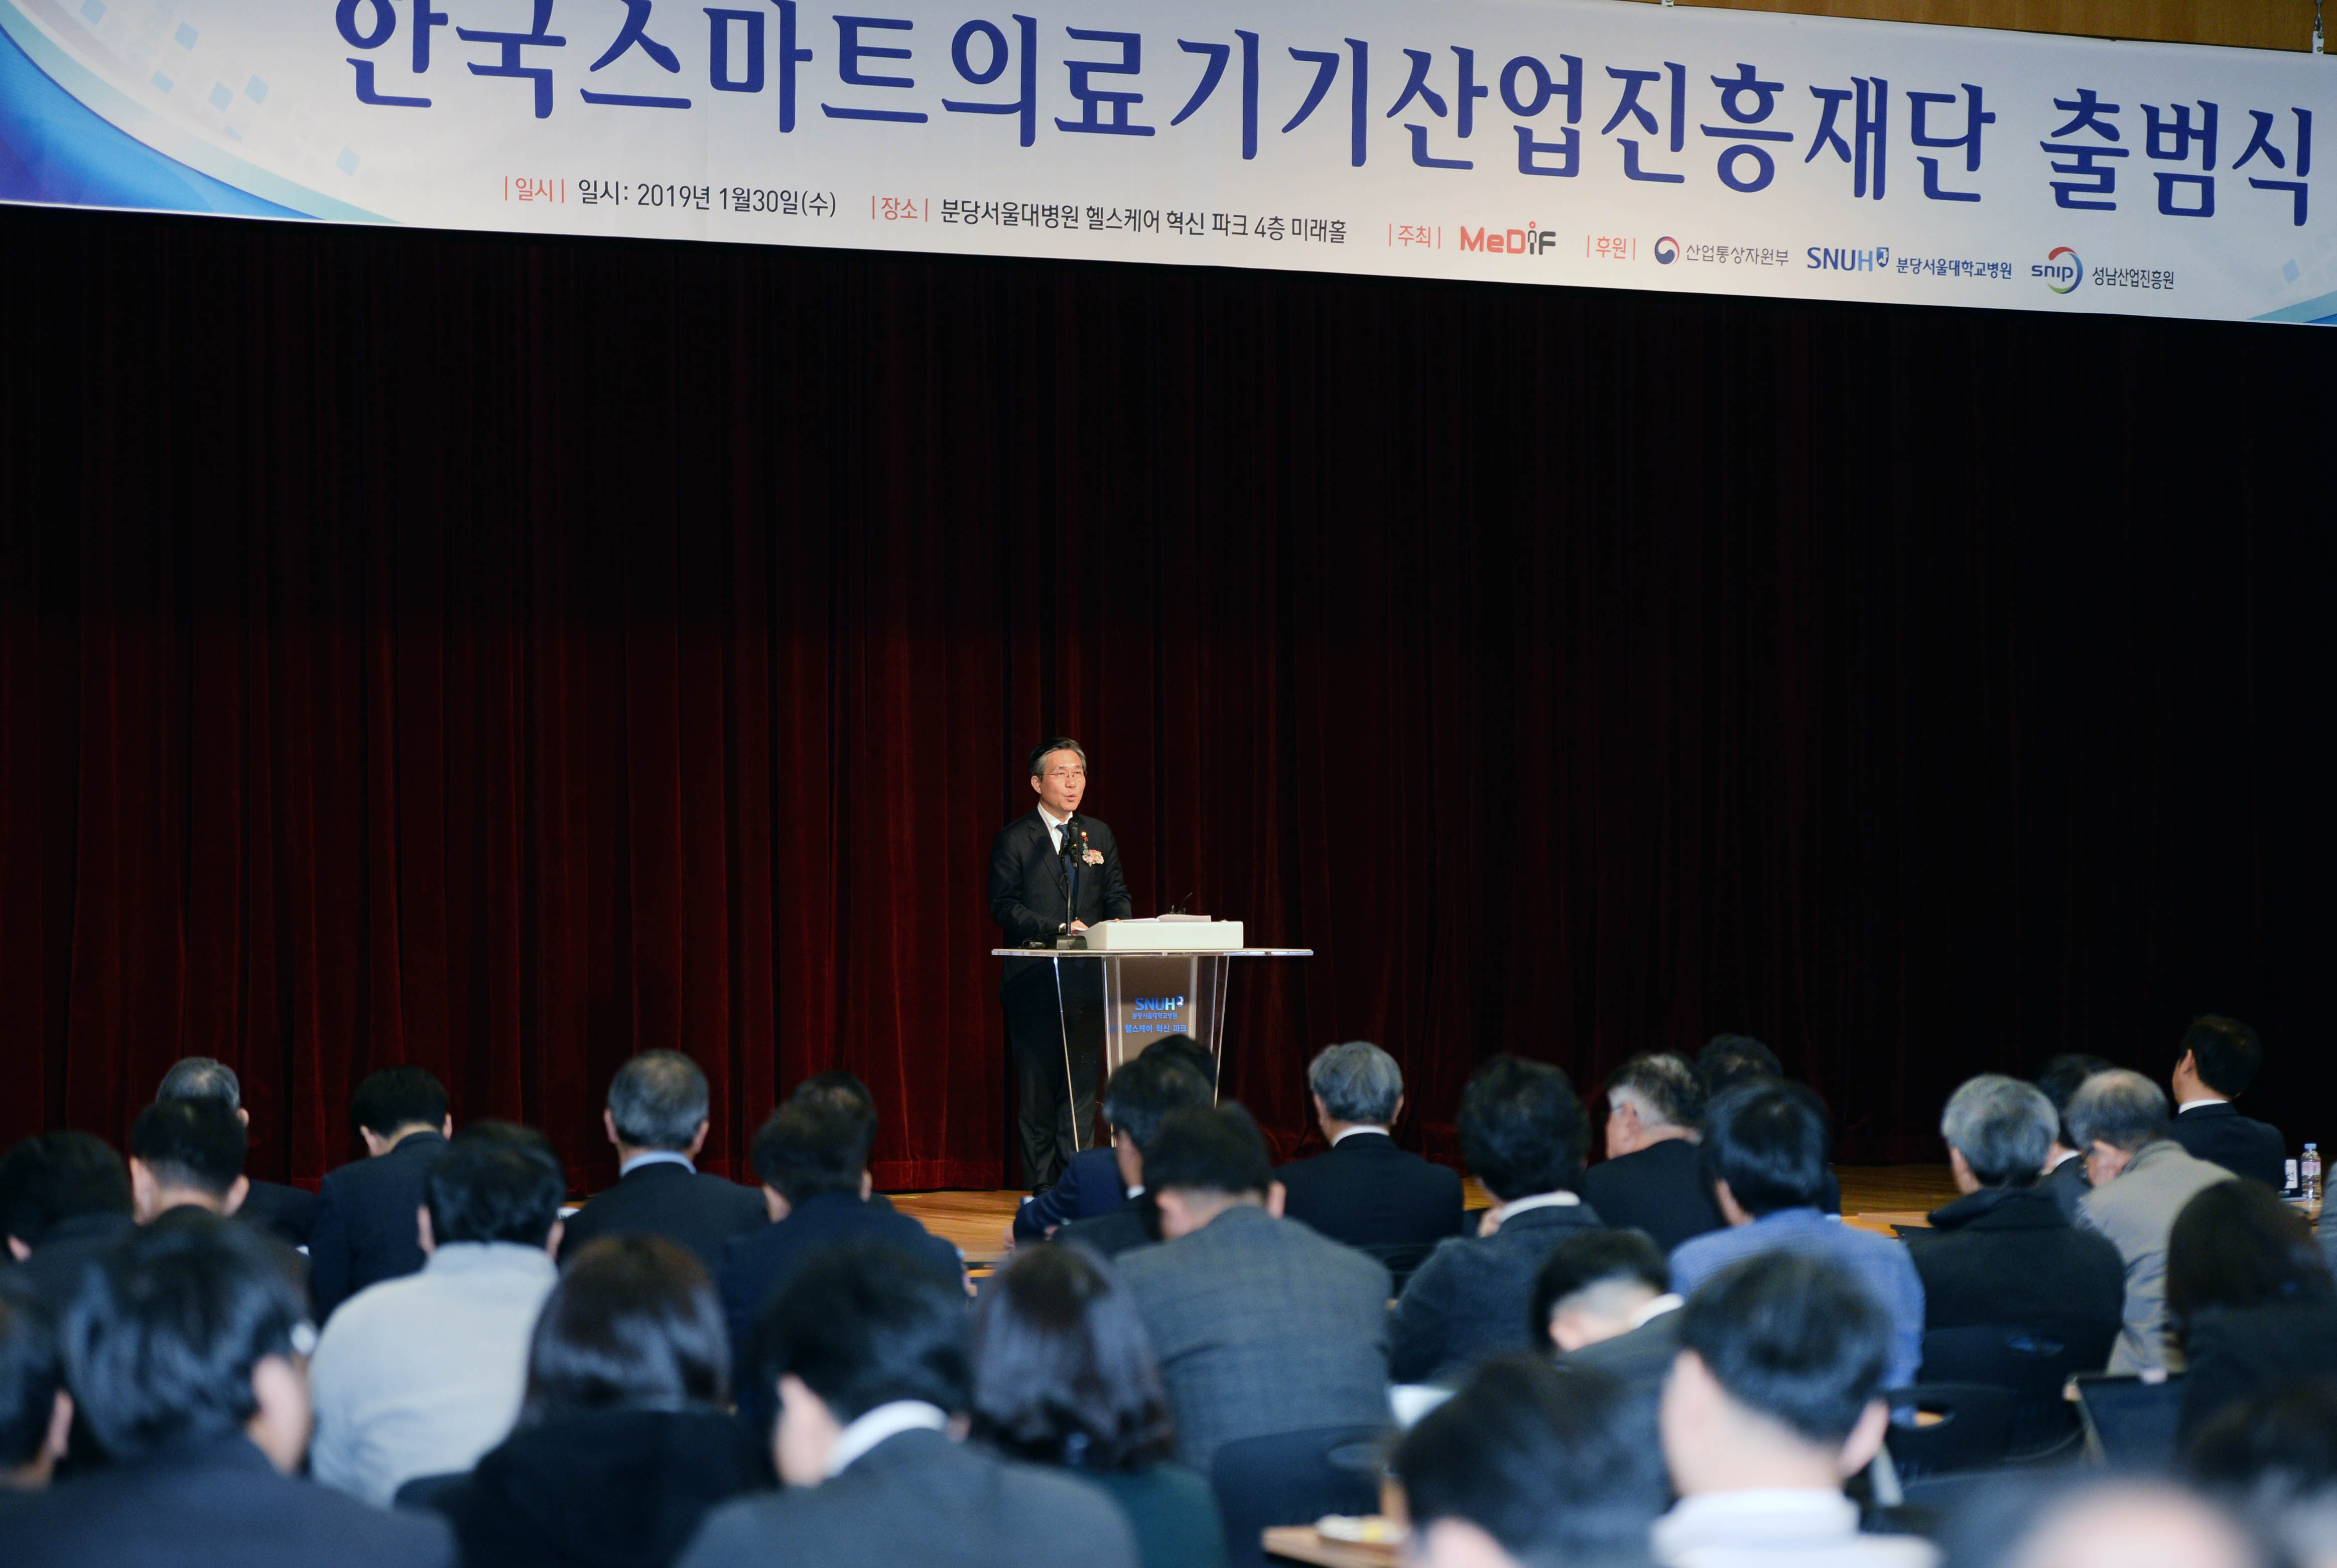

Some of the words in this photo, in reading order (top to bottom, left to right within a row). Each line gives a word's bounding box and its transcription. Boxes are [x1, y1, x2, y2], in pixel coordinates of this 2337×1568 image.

[2040, 88, 2312, 226] 출범식
[638, 184, 709, 210] 2019년
[941, 199, 1078, 229] 분당서울대병원
[1086, 206, 1159, 233] 헬스케어
[1166, 210, 1204, 235] 혁신
[1212, 213, 1248, 236] 파크
[1254, 216, 1285, 240] 4층
[1292, 218, 1346, 243] 미래홀
[1687, 245, 1788, 266] 산업통상자원부
[1807, 247, 1873, 272] SNUH
[1896, 258, 2012, 279] 분당서울대학교병원
[2093, 267, 2173, 289] 성남산업진흥원
[1135, 997, 1176, 1011] SNUH
[1173, 1024, 1187, 1032] 파크
